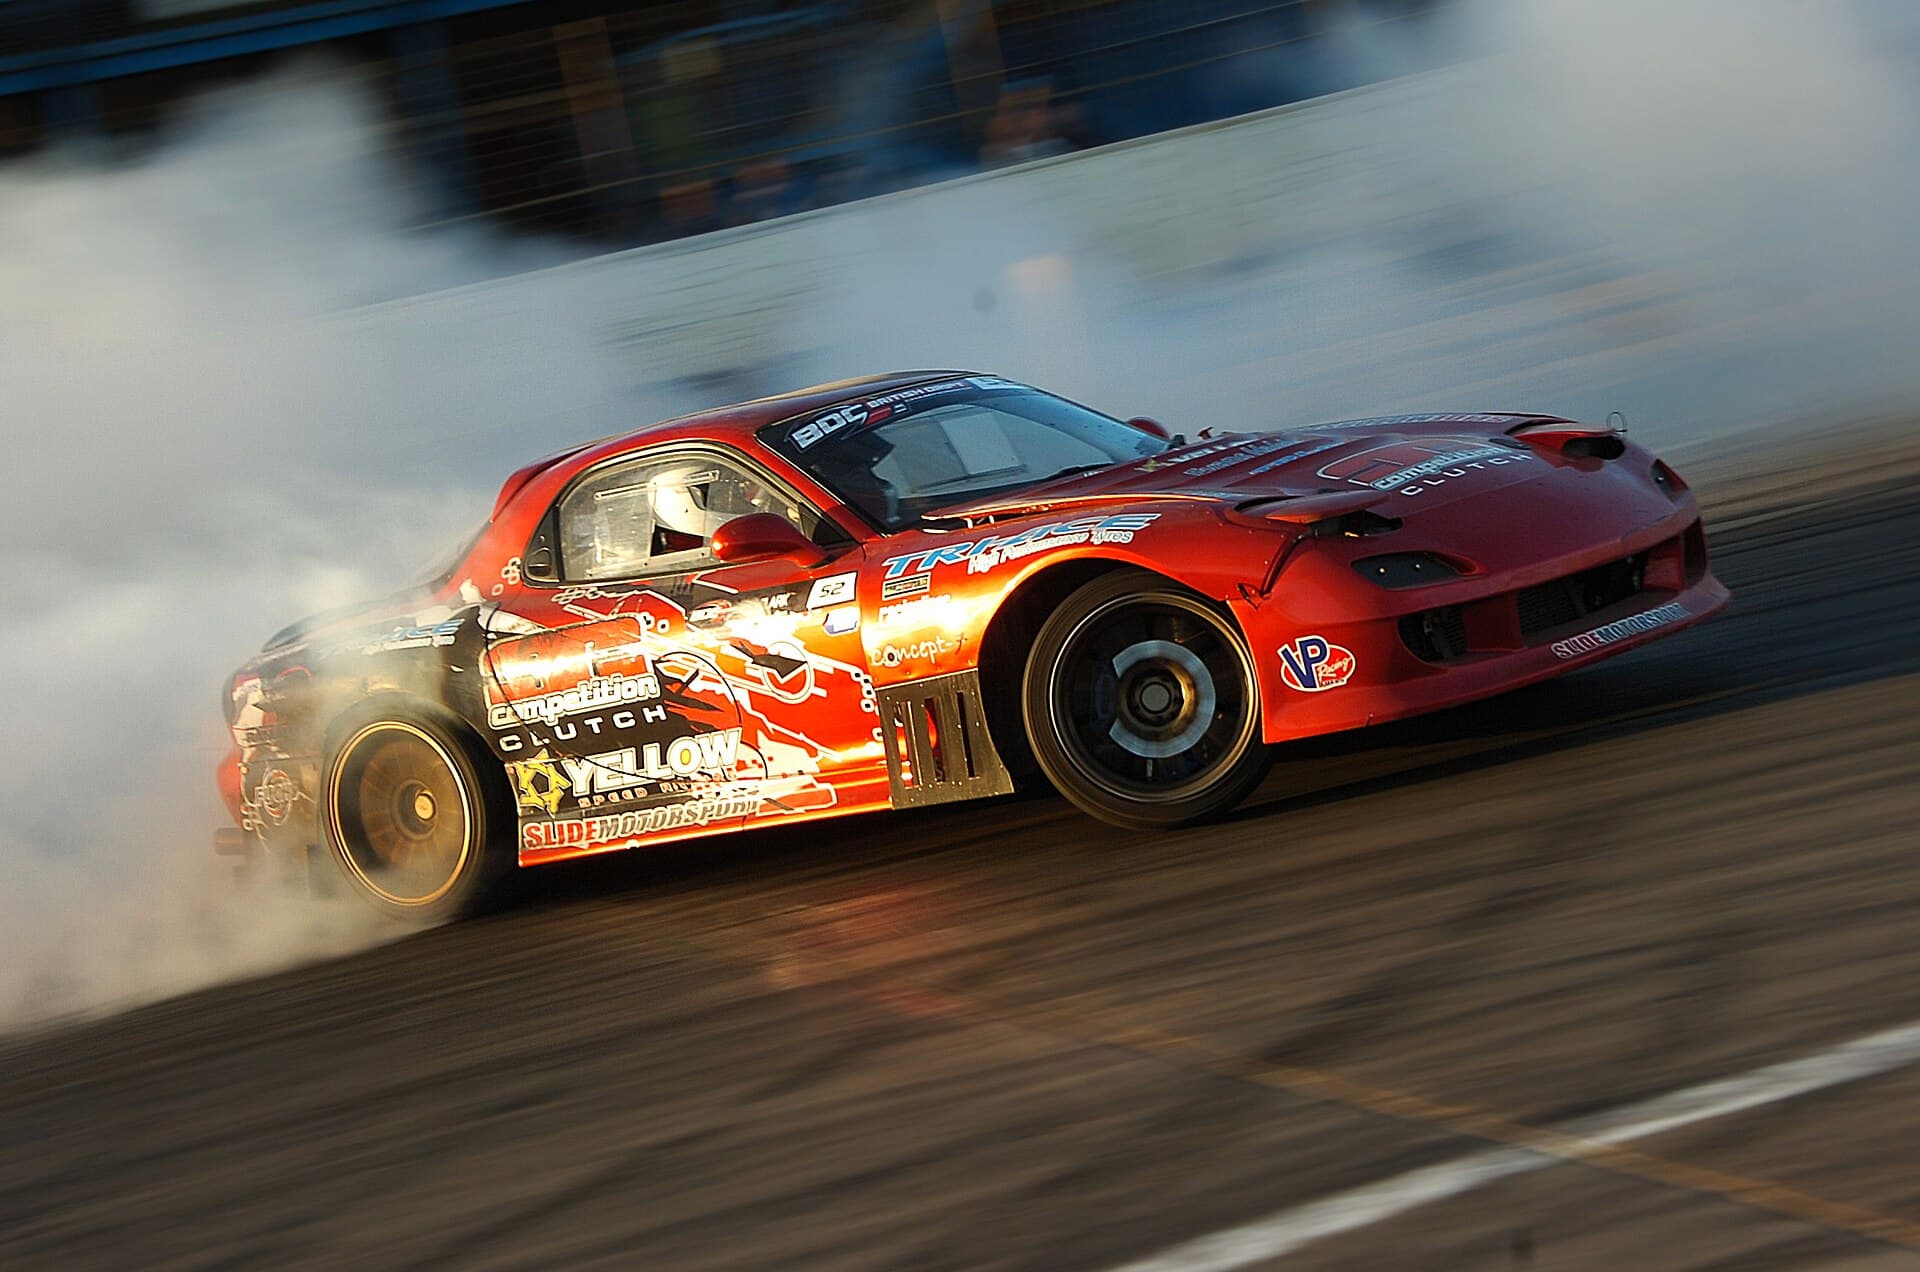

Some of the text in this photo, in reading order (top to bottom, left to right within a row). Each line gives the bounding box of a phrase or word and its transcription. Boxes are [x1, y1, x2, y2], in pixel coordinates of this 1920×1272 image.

[867, 387, 925, 408] BRITISH
[792, 402, 870, 449] BDC
[1370, 447, 1512, 491] competition
[1401, 454, 1533, 496] CLUTCH
[819, 581, 847, 599] 52
[1277, 634, 1331, 690] VP
[487, 675, 661, 731] competition
[499, 704, 667, 752] CLUTCH
[561, 726, 743, 798] YELLOW
[577, 787, 649, 809] SPEED
